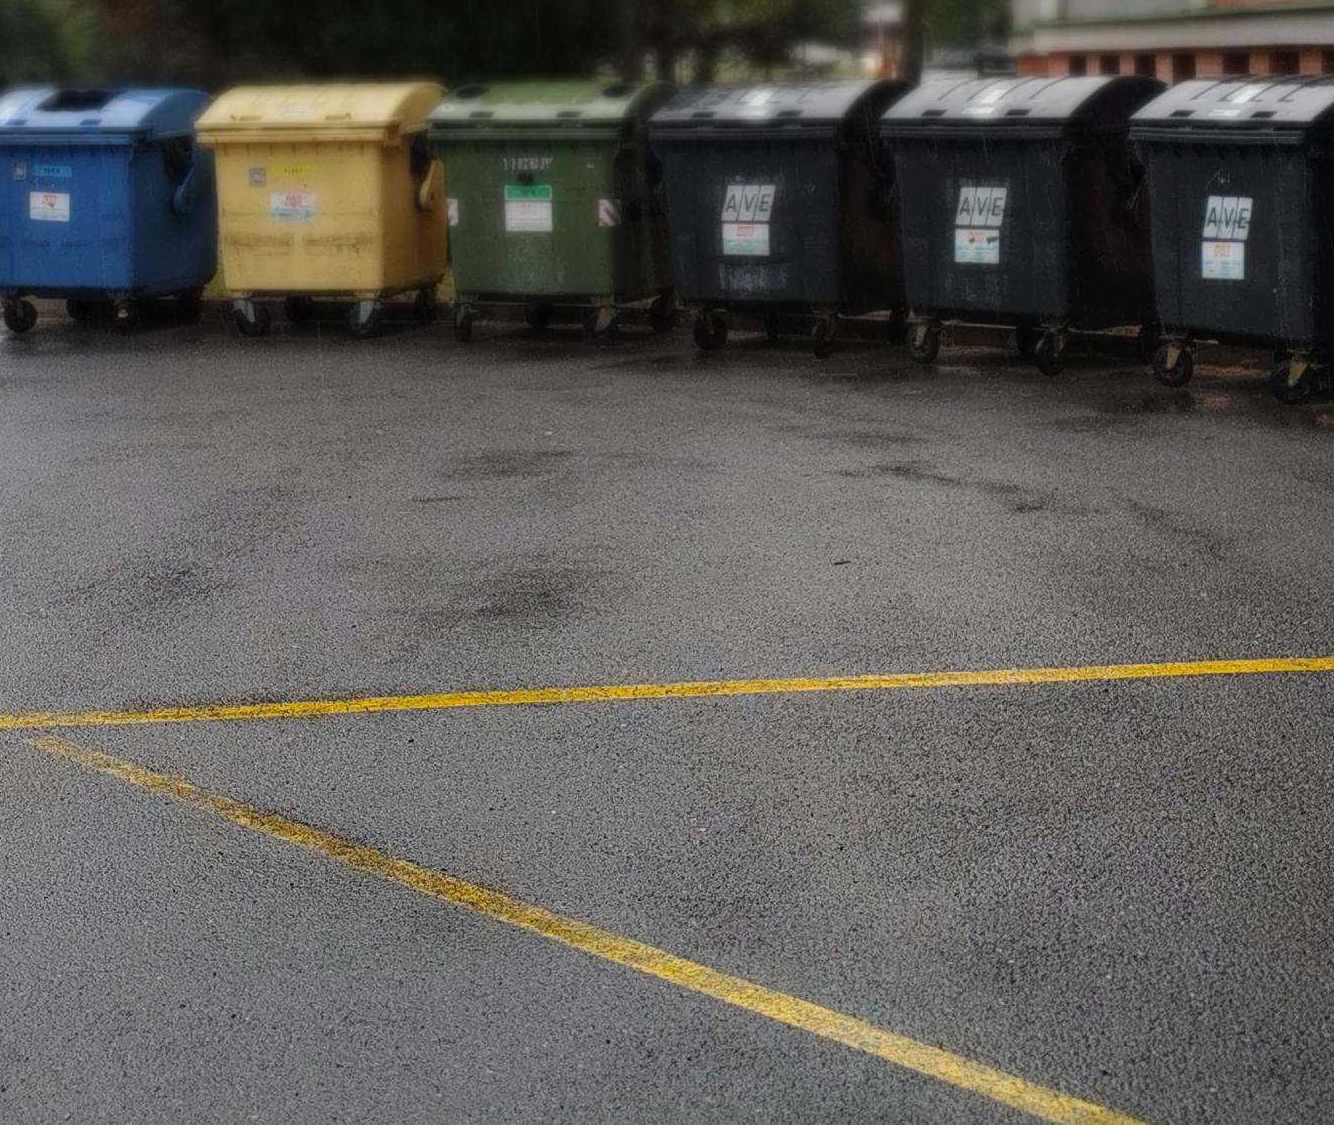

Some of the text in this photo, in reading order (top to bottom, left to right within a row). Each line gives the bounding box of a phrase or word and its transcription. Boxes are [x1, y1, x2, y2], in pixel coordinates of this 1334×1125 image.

[725, 194, 771, 212] AVE
[959, 196, 1003, 216] AVE
[1207, 206, 1250, 229] AVE
